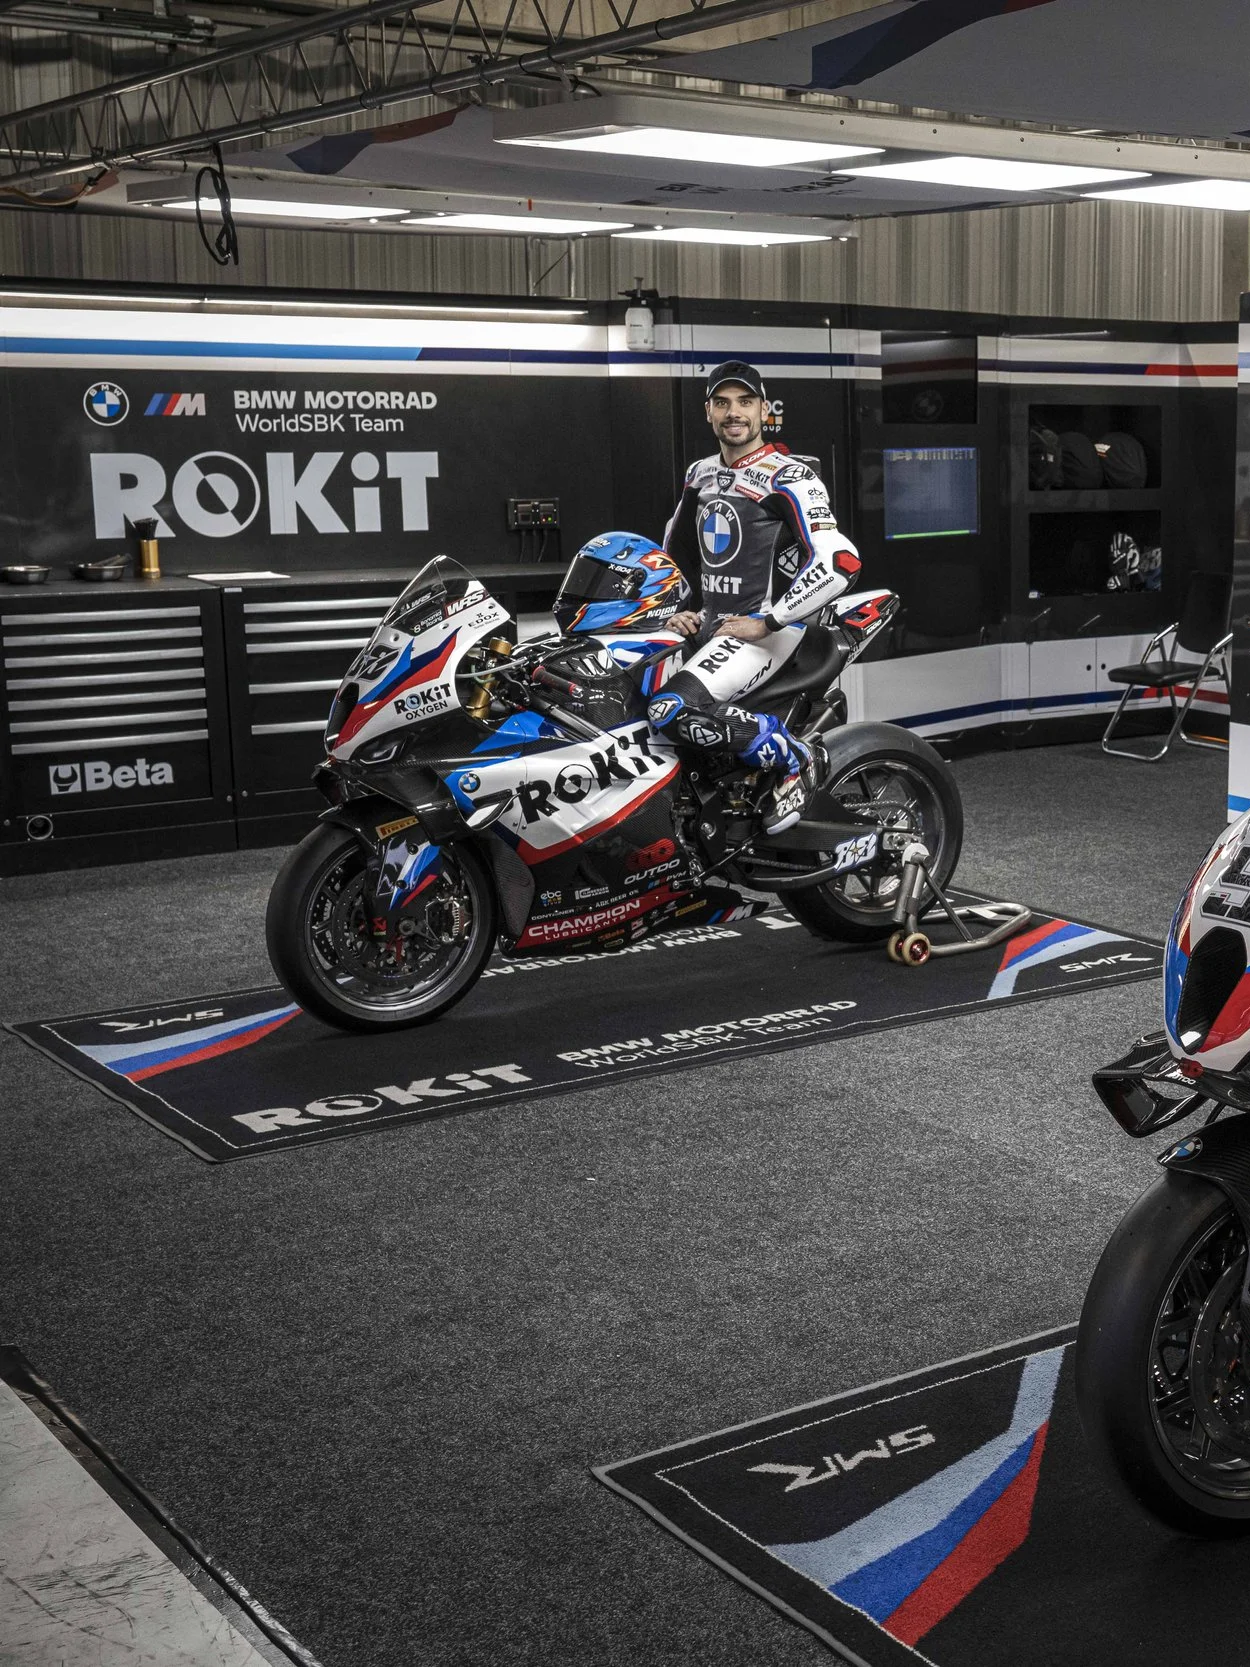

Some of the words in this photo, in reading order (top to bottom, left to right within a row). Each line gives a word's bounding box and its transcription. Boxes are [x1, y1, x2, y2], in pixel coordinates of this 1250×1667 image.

[234, 391, 296, 409] BMW
[304, 391, 437, 410] MOTORRAD
[236, 414, 345, 433] WorldSBK
[350, 414, 404, 433] Team
[738, 450, 766, 468] IXON
[744, 468, 770, 483] ROKiT
[90, 451, 439, 539] ROKiT
[785, 561, 830, 603] ROKiT
[787, 597, 806, 611] BMW
[802, 576, 835, 601] MOTORRAD
[447, 588, 487, 616] WRS
[646, 605, 677, 619] NOLAN
[394, 683, 451, 715] ROKiT
[405, 700, 448, 721] OXYGEN
[84, 758, 174, 792] Beta
[516, 726, 668, 824] ROKiT
[624, 858, 680, 885] OUTDO
[540, 889, 562, 900] ebc
[528, 899, 641, 938] CHAMPION
[545, 914, 626, 941] LUBRICANTS
[1059, 953, 1154, 972] SMR
[556, 1038, 654, 1063] BMW
[661, 1000, 858, 1041] MOTORRAD
[575, 1032, 746, 1069] WorldSBK
[744, 1017, 832, 1036] Team
[232, 1063, 533, 1134] ROKiT
[747, 1424, 935, 1492] SMR
